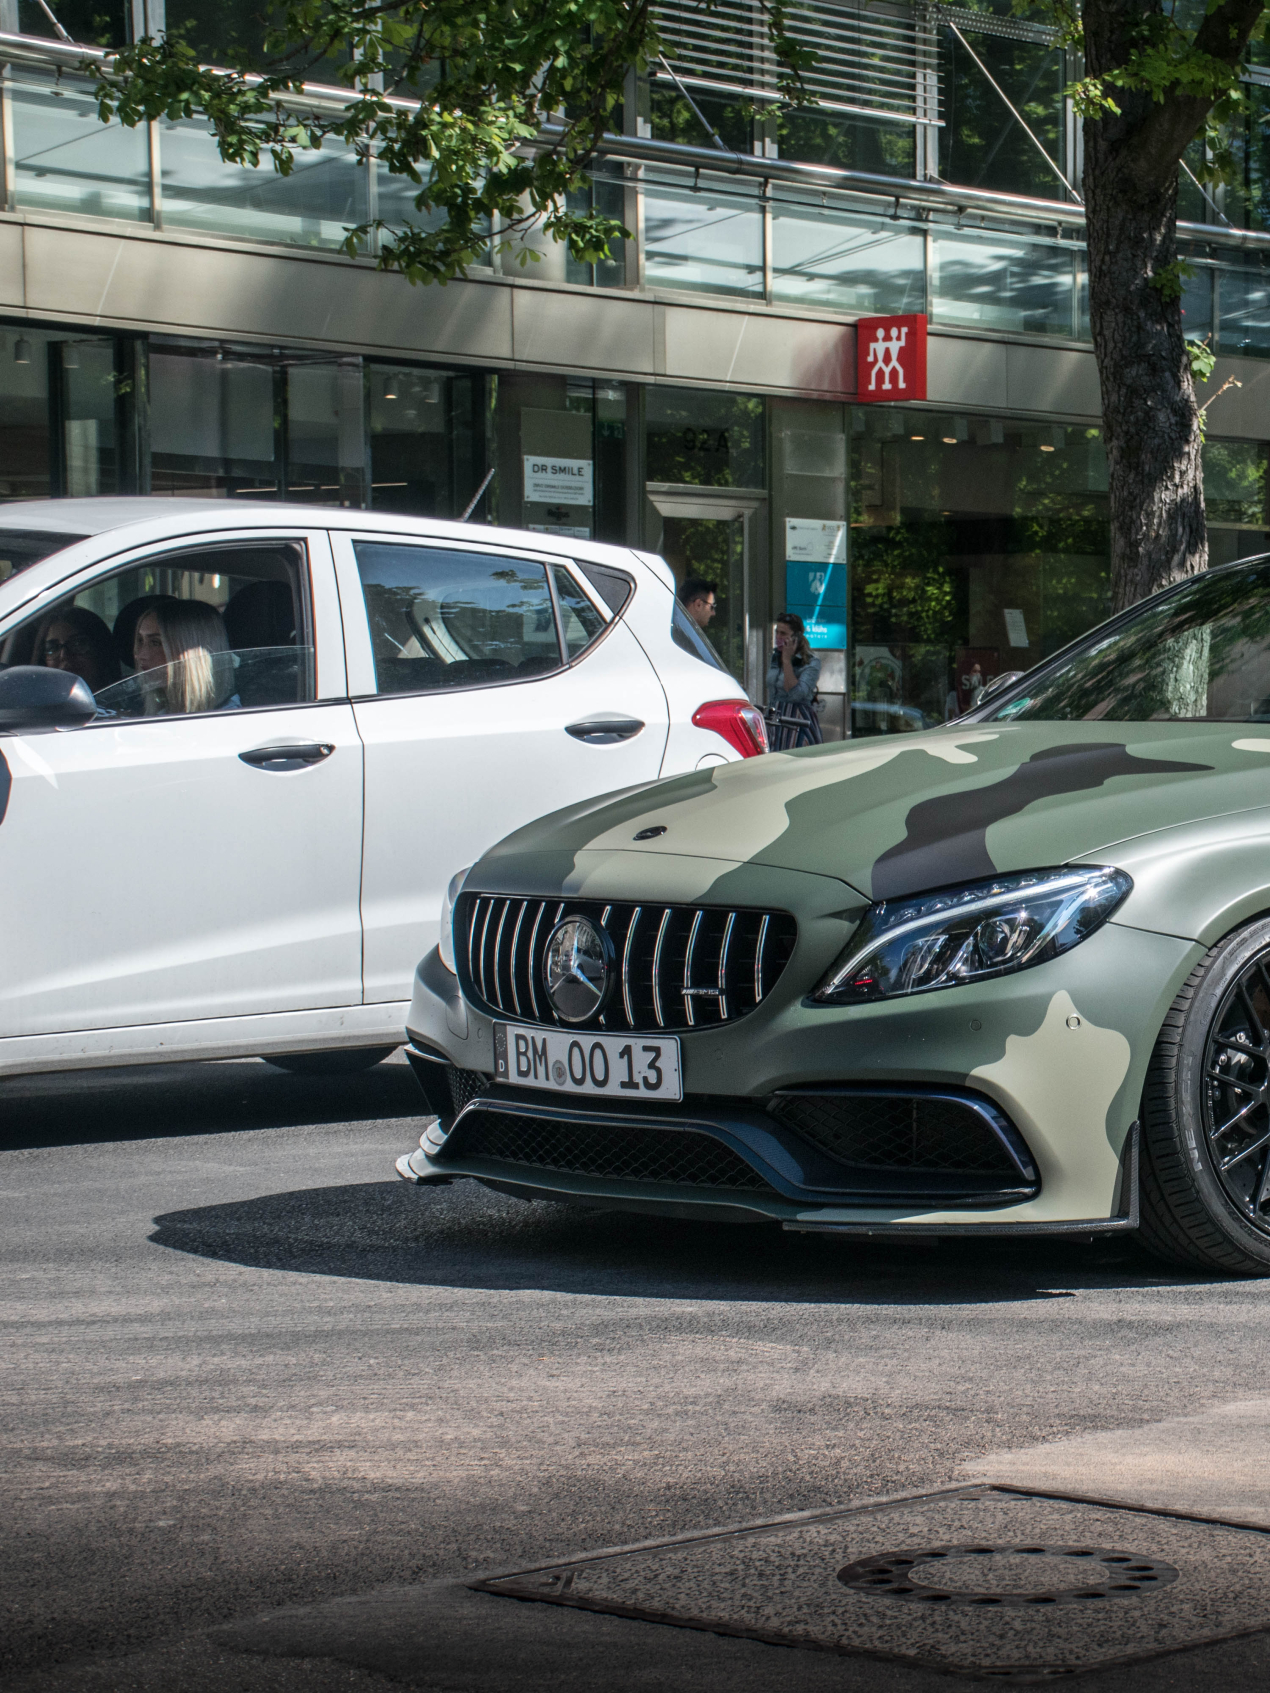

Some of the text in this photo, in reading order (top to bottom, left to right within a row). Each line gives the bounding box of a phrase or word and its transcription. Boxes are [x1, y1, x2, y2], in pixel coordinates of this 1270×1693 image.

[532, 463, 585, 477] DR SMILE
[499, 1060, 506, 1072] D
[514, 1033, 550, 1082] BM
[618, 1044, 663, 1091] 13
